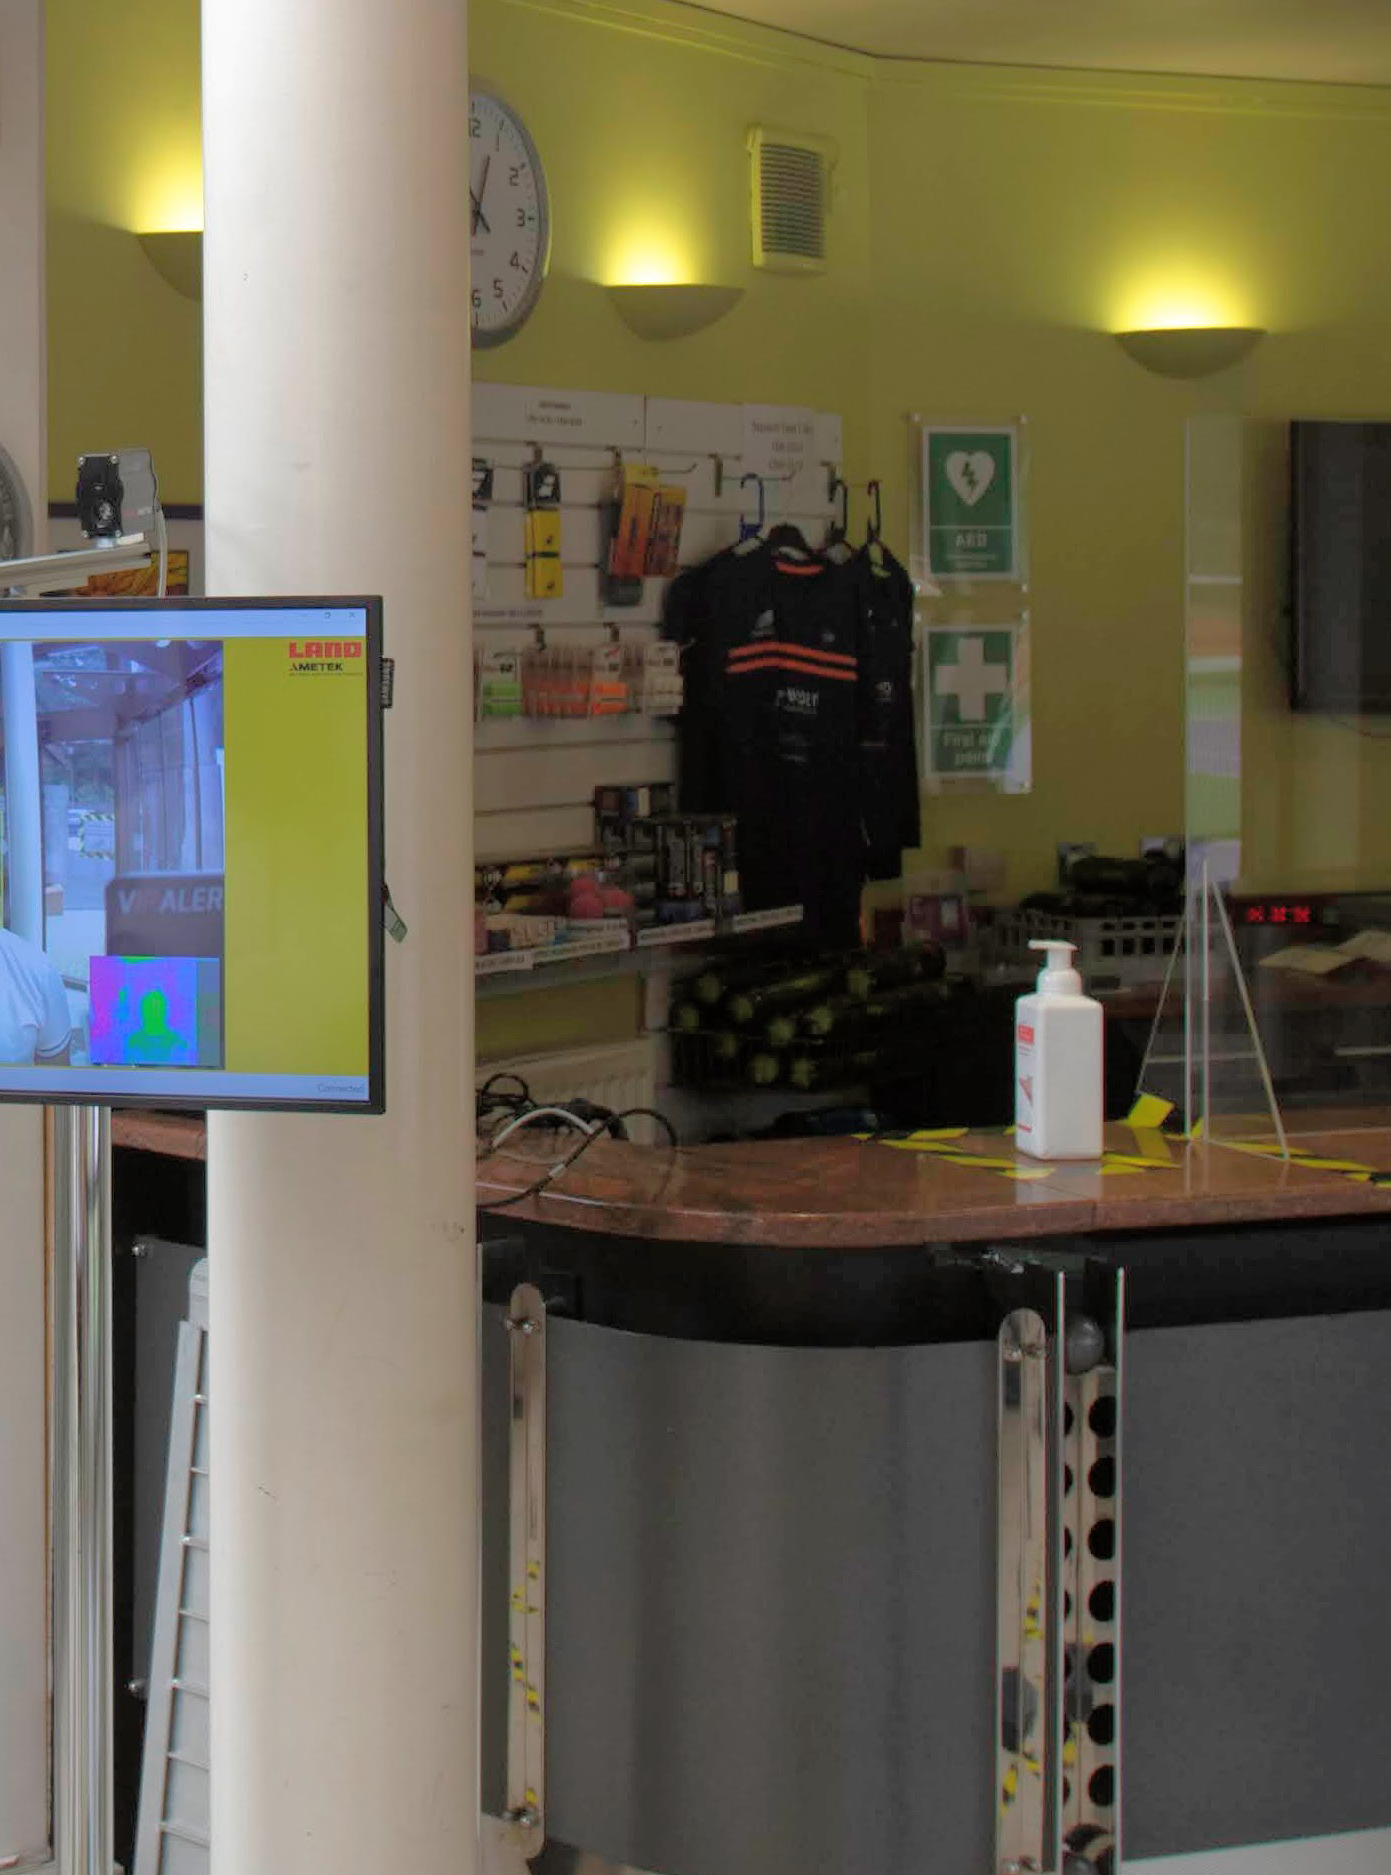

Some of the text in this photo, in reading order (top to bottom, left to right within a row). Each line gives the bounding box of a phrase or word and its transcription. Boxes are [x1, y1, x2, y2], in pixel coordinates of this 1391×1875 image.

[509, 166, 519, 186] 2
[517, 208, 526, 227] 3
[510, 251, 521, 270] 4
[493, 279, 504, 299] 5
[472, 289, 482, 309] 6
[288, 641, 362, 659] LAND
[289, 662, 344, 672] AMETEK
